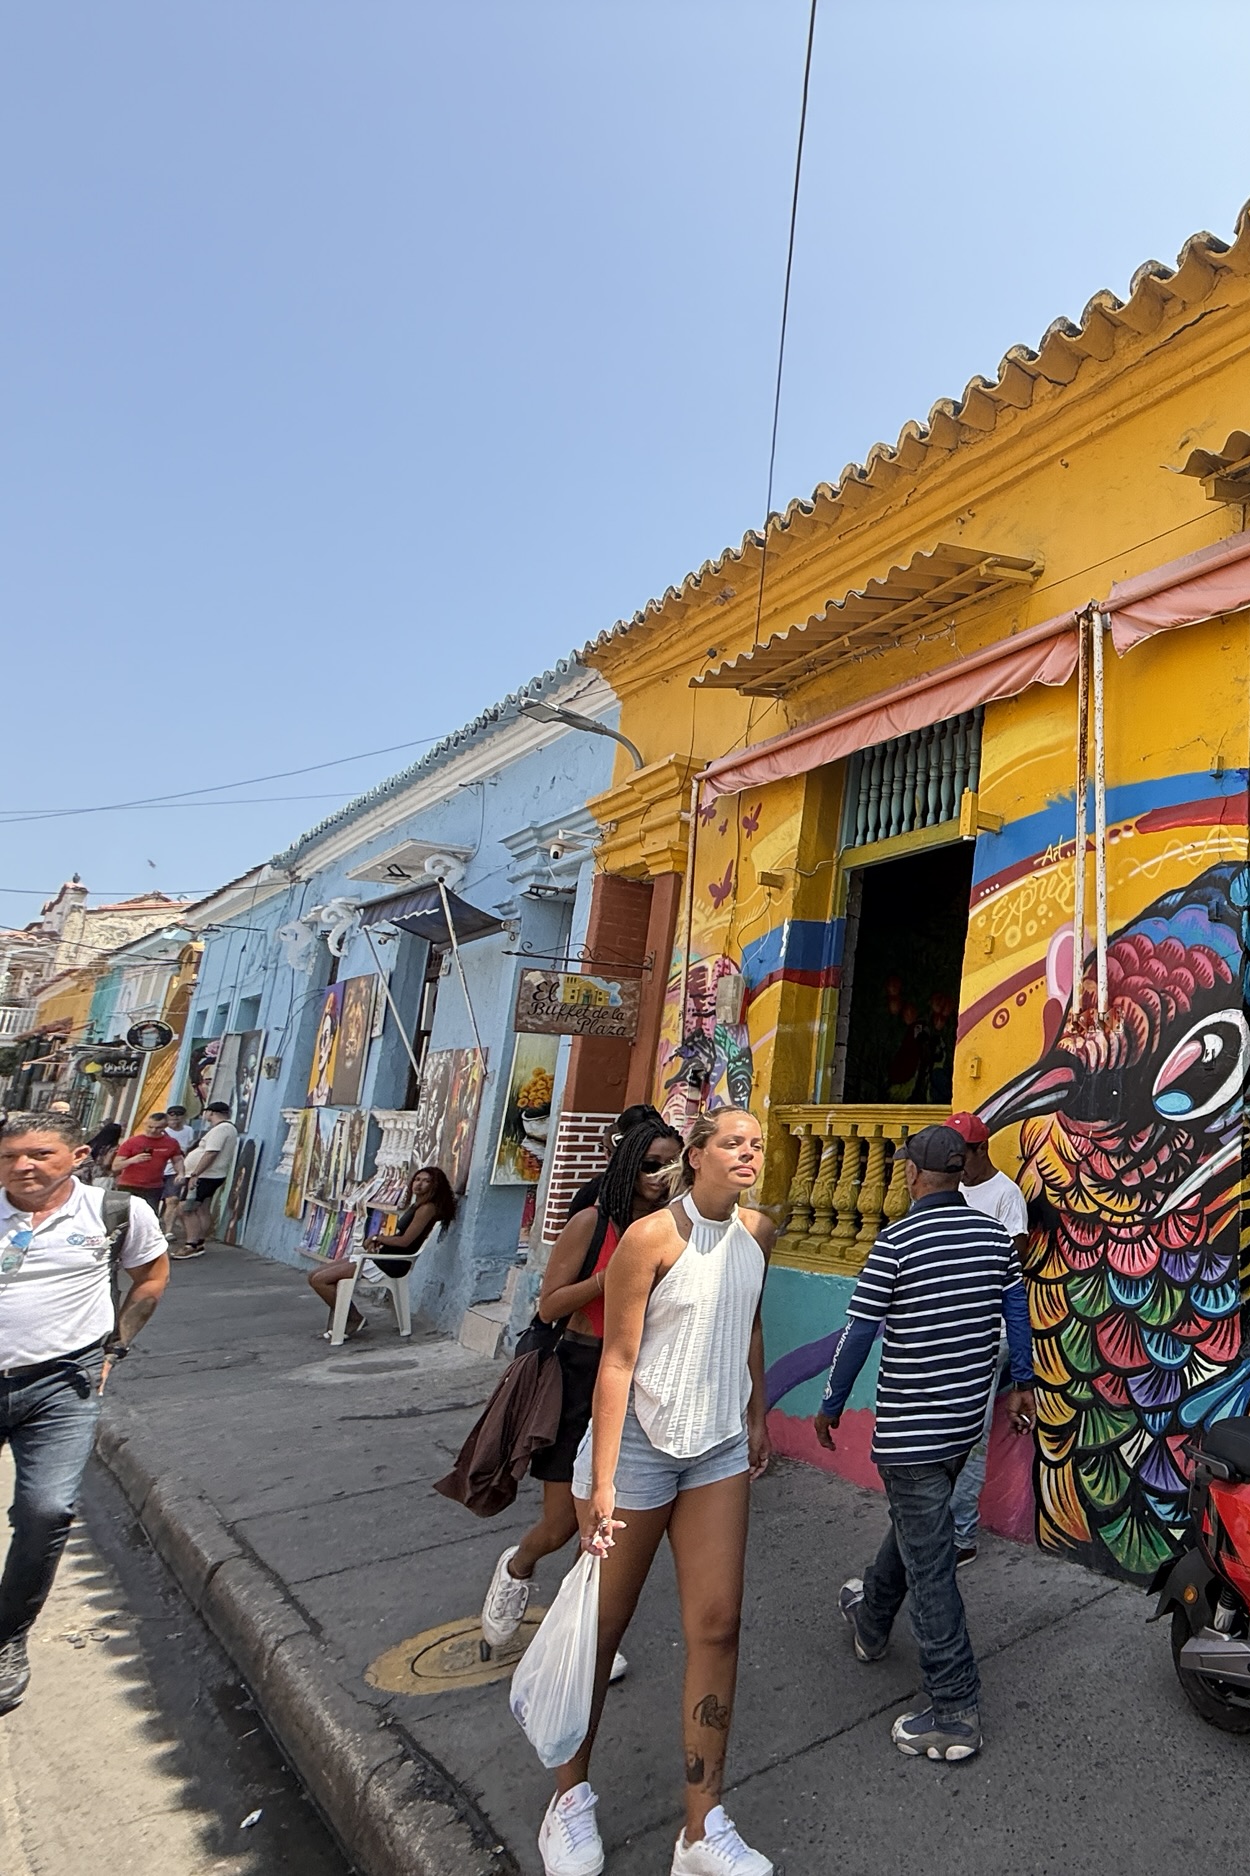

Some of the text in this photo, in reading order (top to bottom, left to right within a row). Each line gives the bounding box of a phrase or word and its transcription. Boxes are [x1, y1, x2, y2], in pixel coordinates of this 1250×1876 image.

[532, 981, 561, 1002] El
[527, 1001, 625, 1022] Buffet de la
[574, 1017, 627, 1036] Plaza
